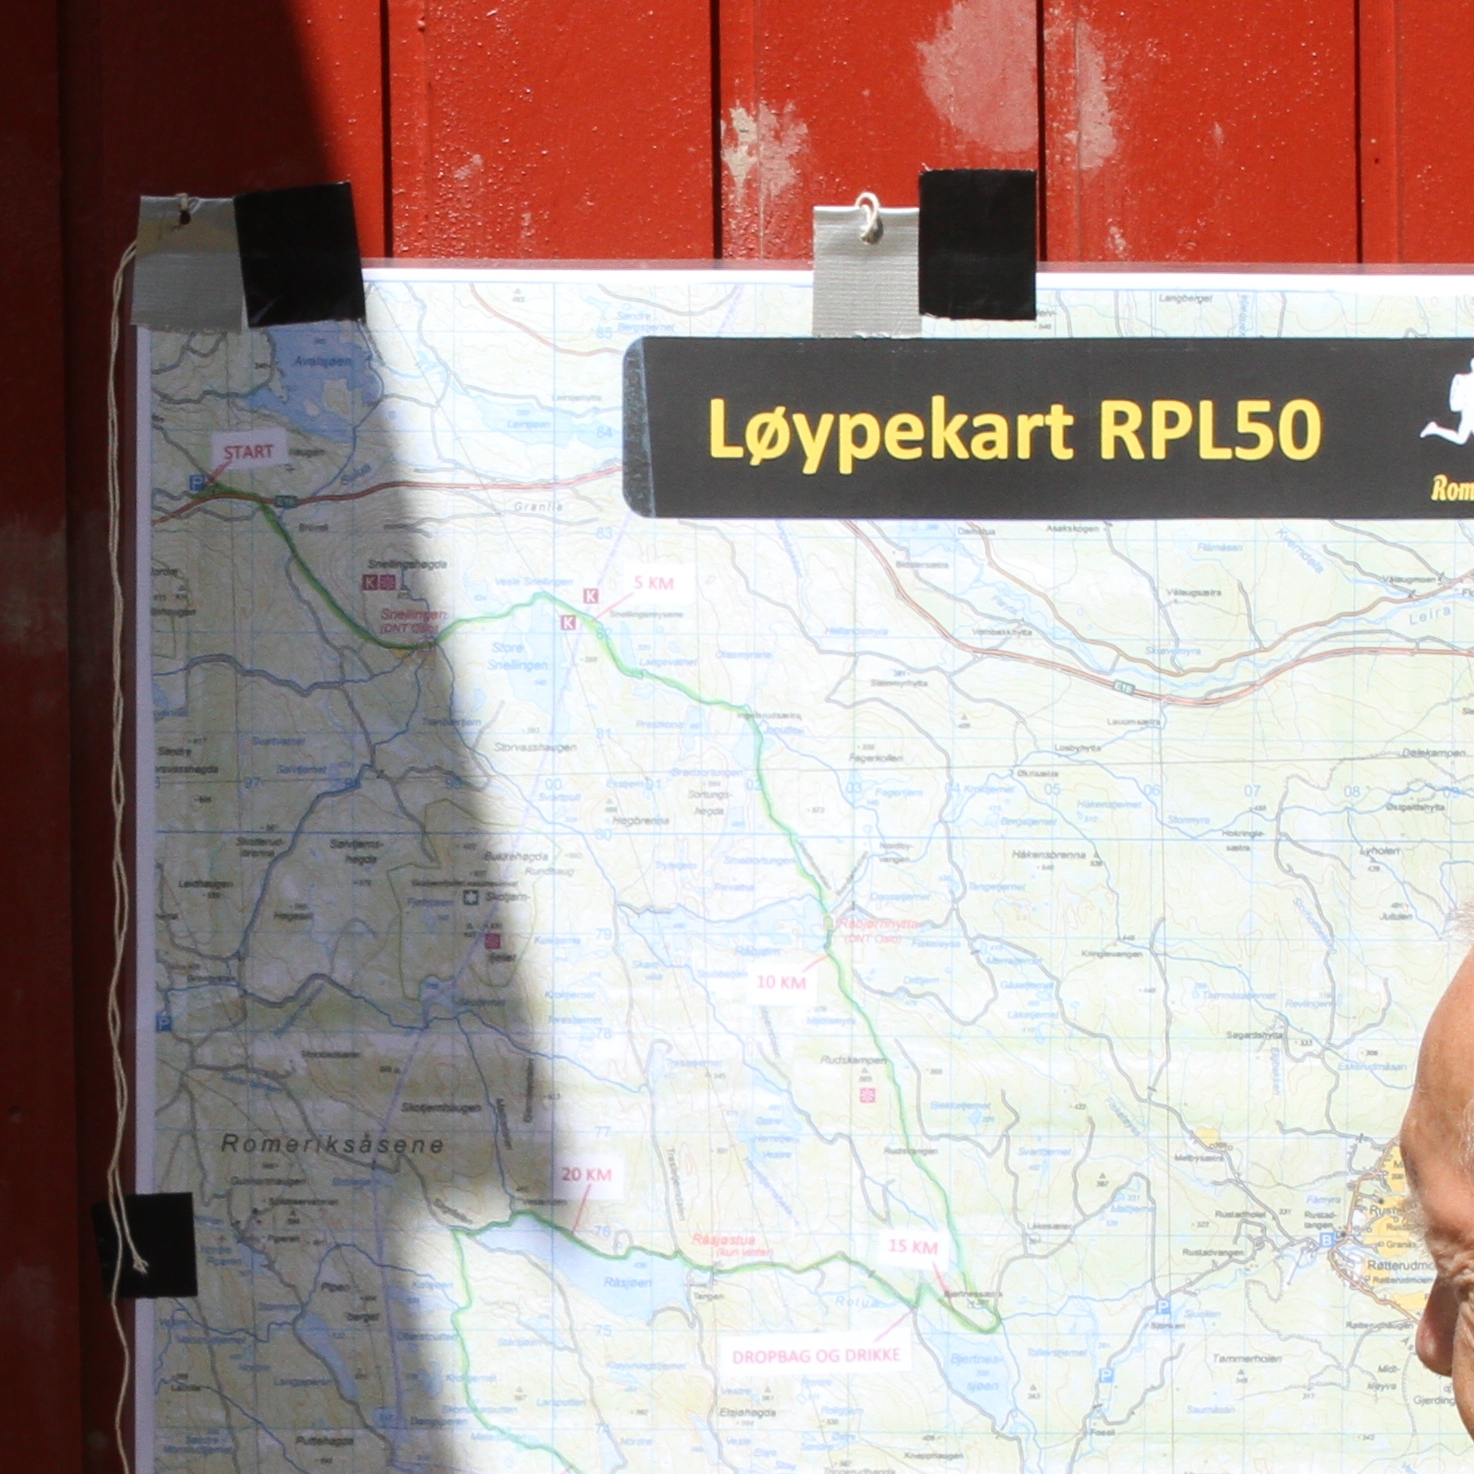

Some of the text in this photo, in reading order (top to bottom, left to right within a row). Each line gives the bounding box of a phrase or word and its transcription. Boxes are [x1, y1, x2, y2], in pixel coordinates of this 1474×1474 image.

[710, 397, 1322, 475] Løypekart RPL50
[224, 444, 273, 460] START
[634, 576, 674, 590] 5 KM
[545, 779, 562, 790] 00
[1045, 784, 1061, 795] 05
[1144, 784, 1160, 796] 06
[1244, 786, 1261, 797] 07
[595, 928, 611, 940] 79
[756, 976, 806, 990] 10 KM
[596, 1028, 611, 1039] 78
[595, 1126, 610, 1137] 77
[222, 1132, 445, 1154] Romeriksåsene
[562, 1168, 611, 1181] 20 KM
[888, 1239, 938, 1254] 15 KM
[732, 1348, 900, 1365] DROPBAG OG DRIKKE
